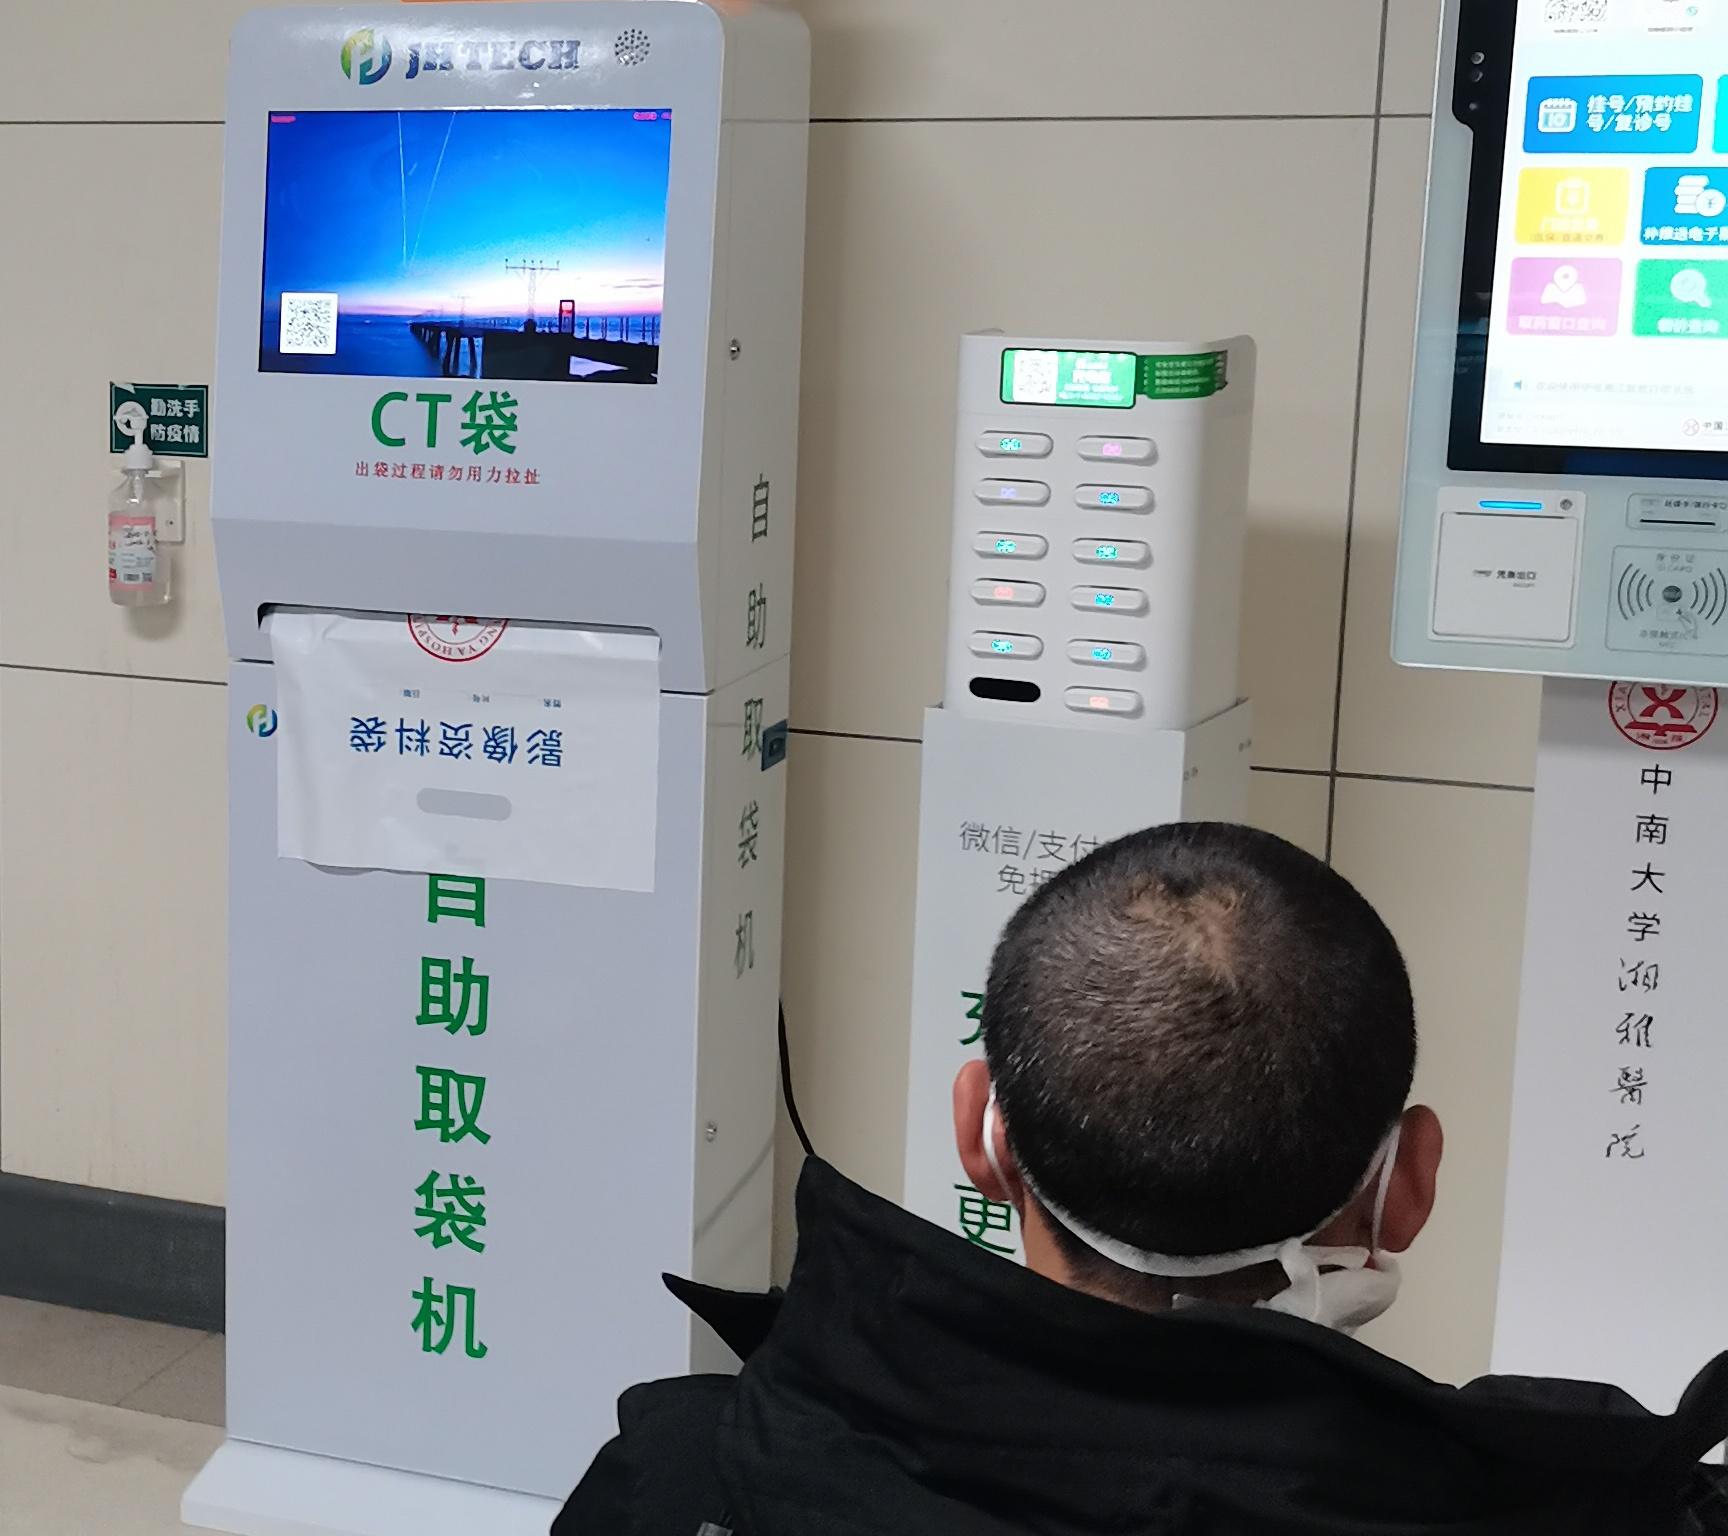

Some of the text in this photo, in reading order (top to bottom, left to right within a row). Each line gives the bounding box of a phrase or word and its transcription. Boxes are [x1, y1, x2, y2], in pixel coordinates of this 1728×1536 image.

[150, 398, 201, 418] 勤洗手
[150, 423, 201, 444] 防疫情
[371, 390, 520, 456] CT袋
[355, 460, 541, 485] 出袋过程请勿用力拉扯
[349, 715, 564, 768] 影像资料袋
[735, 472, 770, 981] 自助取袋机
[411, 874, 492, 1359] 自助取袋机
